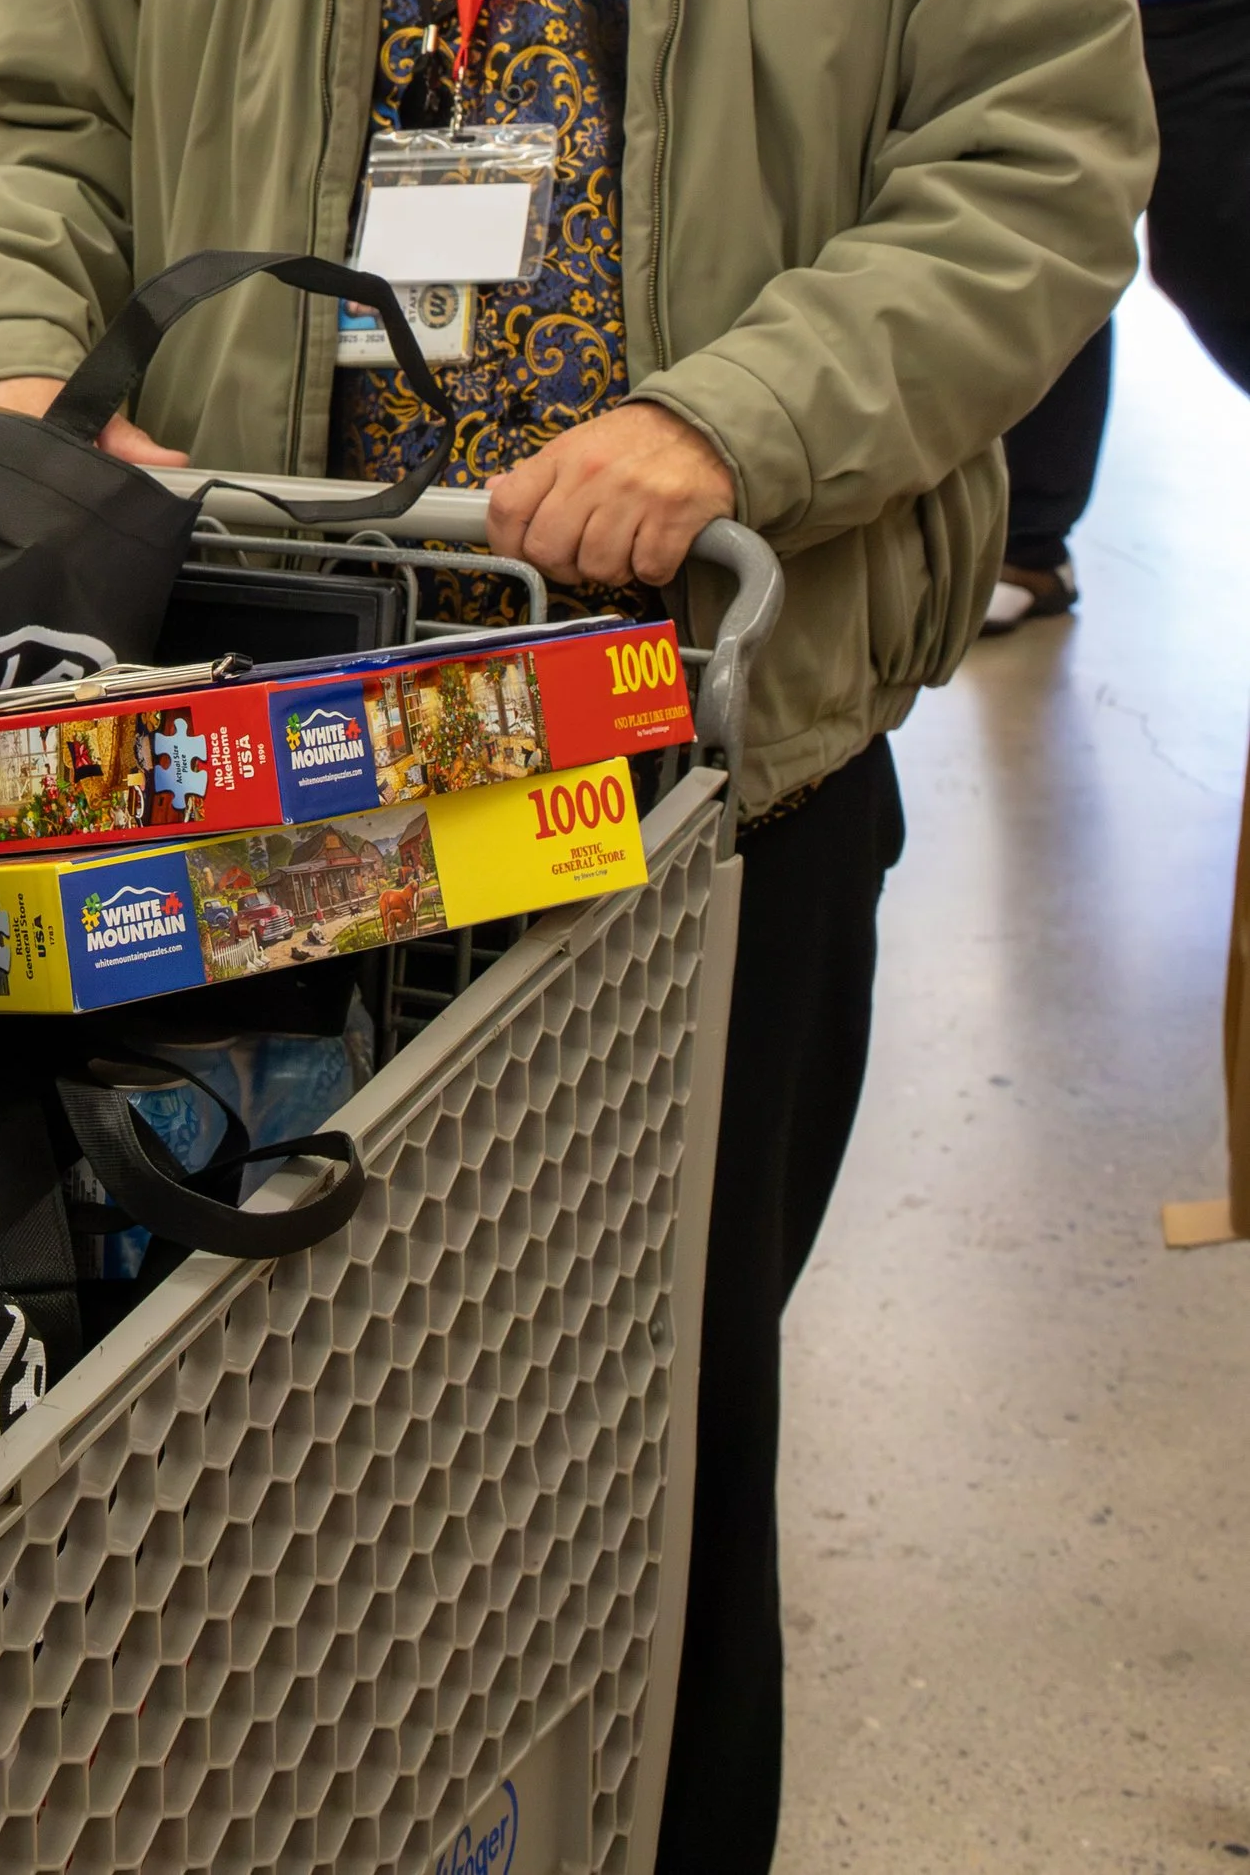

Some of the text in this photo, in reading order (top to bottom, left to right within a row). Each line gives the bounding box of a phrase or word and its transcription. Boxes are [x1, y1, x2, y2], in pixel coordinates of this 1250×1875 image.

[605, 638, 677, 695] 1000
[257, 743, 266, 764] 1896
[301, 723, 346, 747] WHITE
[172, 745, 183, 784] Actual Size
[210, 732, 224, 787] No Place
[239, 734, 255, 778] USA
[291, 739, 364, 770] MOUNTAIN
[298, 768, 363, 787] whitemountainpuzzles.com
[527, 775, 626, 840] 1000
[551, 849, 626, 875] GENERAL STORE
[570, 842, 604, 859] RUSTIC
[101, 899, 162, 927] WHITE
[13, 917, 23, 955] Rustic
[17, 893, 34, 980] General Store
[33, 915, 47, 958] USA
[87, 913, 186, 952] MOUNTAIN
[94, 944, 183, 969] whitemountainpuzzles.com
